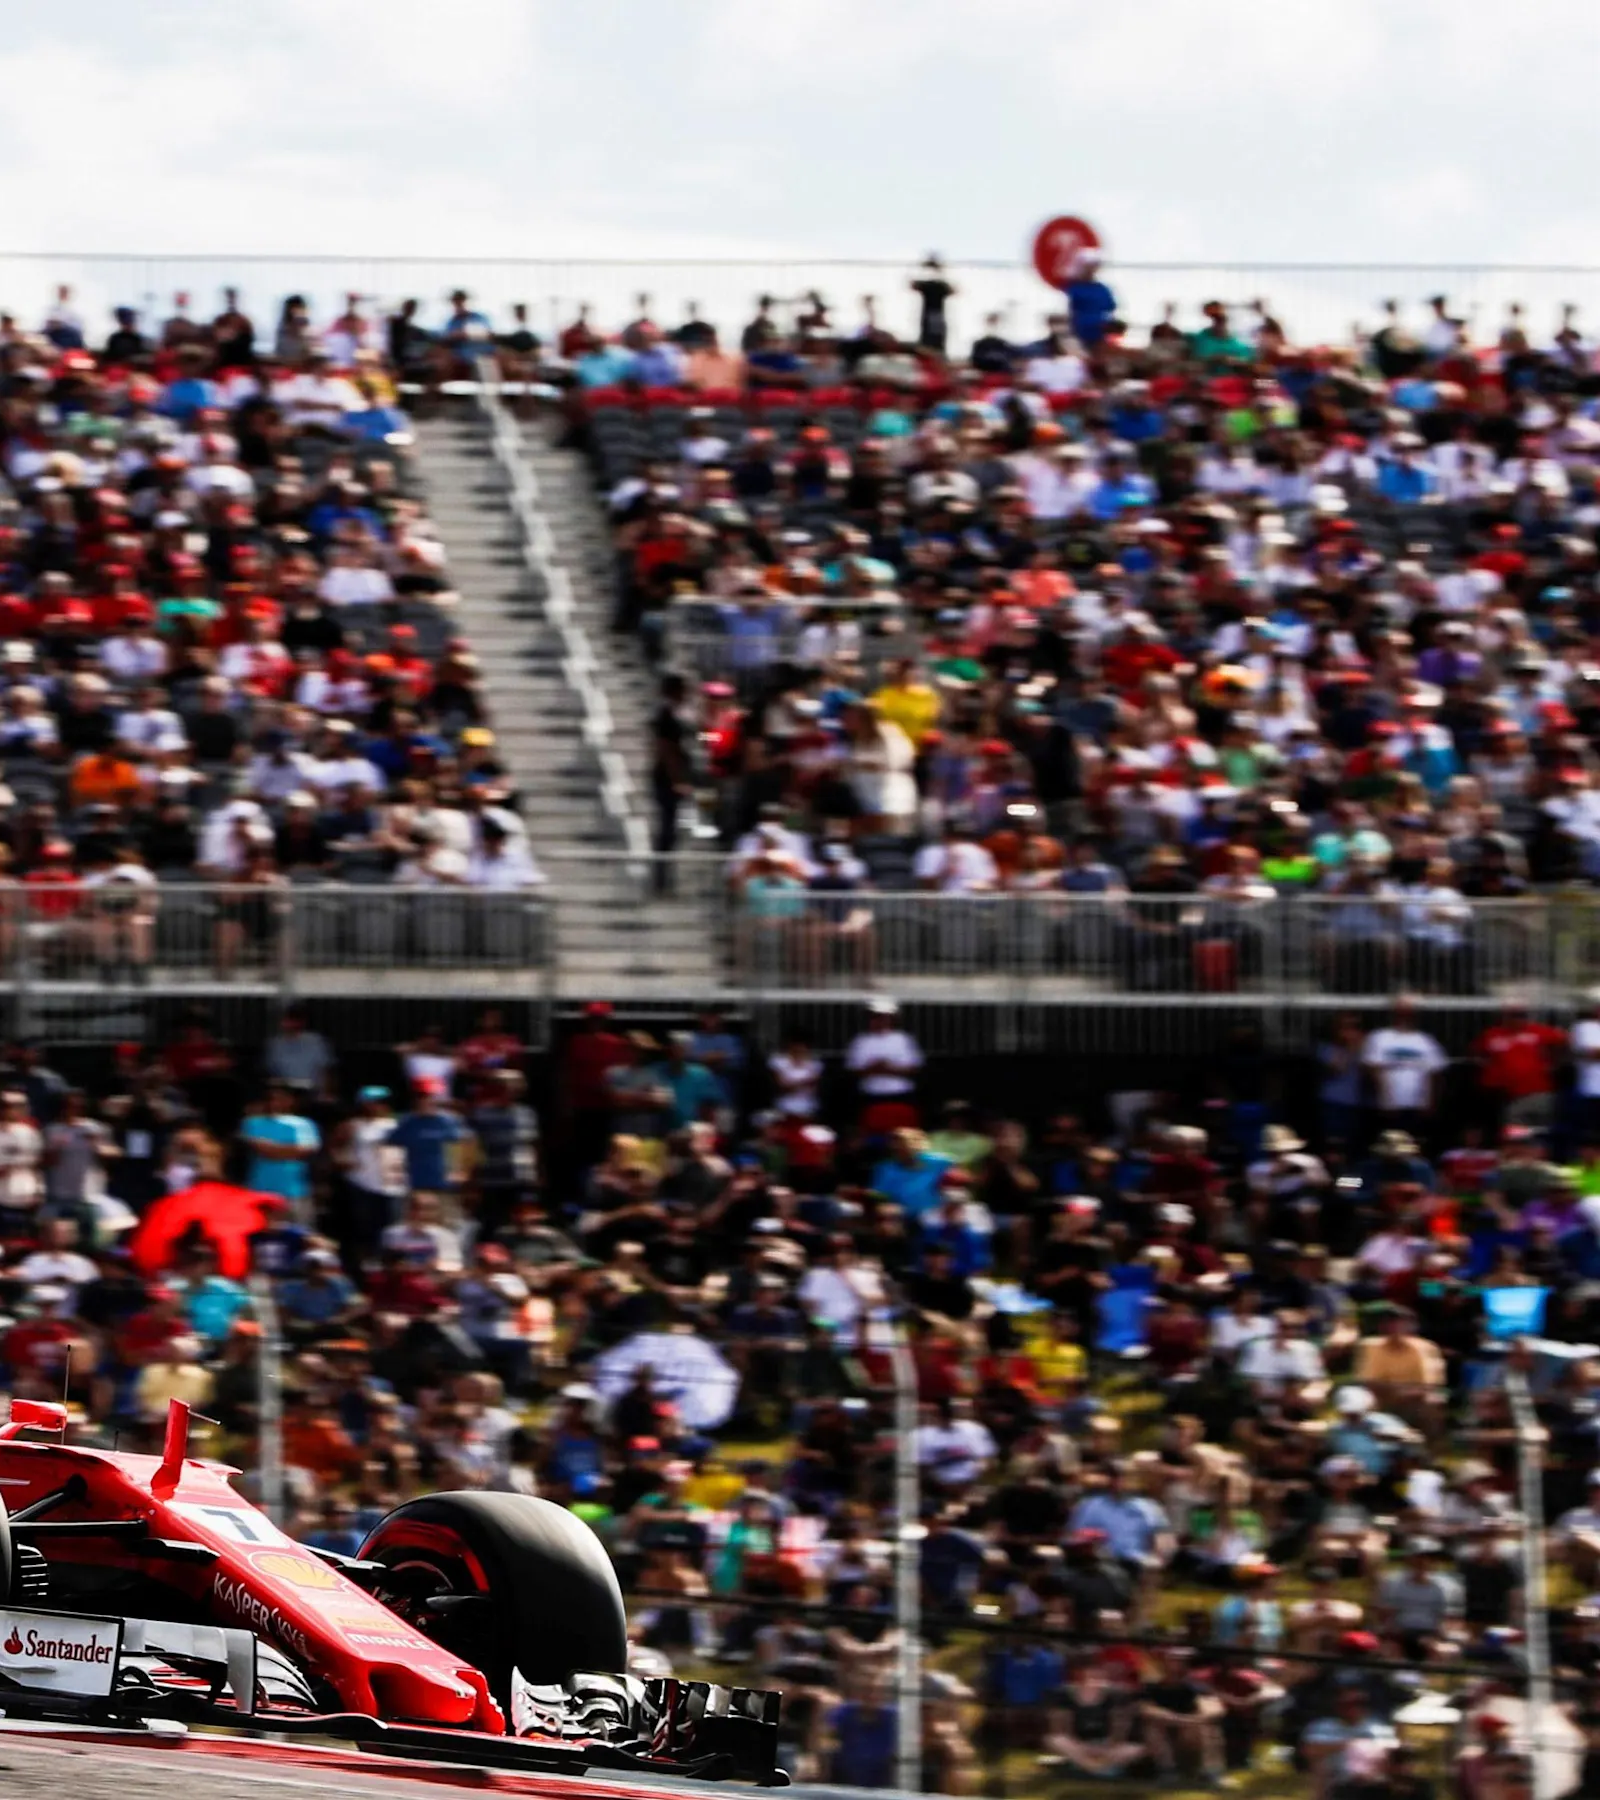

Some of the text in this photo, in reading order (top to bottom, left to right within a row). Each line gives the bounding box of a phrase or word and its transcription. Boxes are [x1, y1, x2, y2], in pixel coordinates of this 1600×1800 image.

[201, 1508, 261, 1541] 7
[213, 1572, 298, 1646] KASPERSKY
[25, 1629, 113, 1664] Santander
